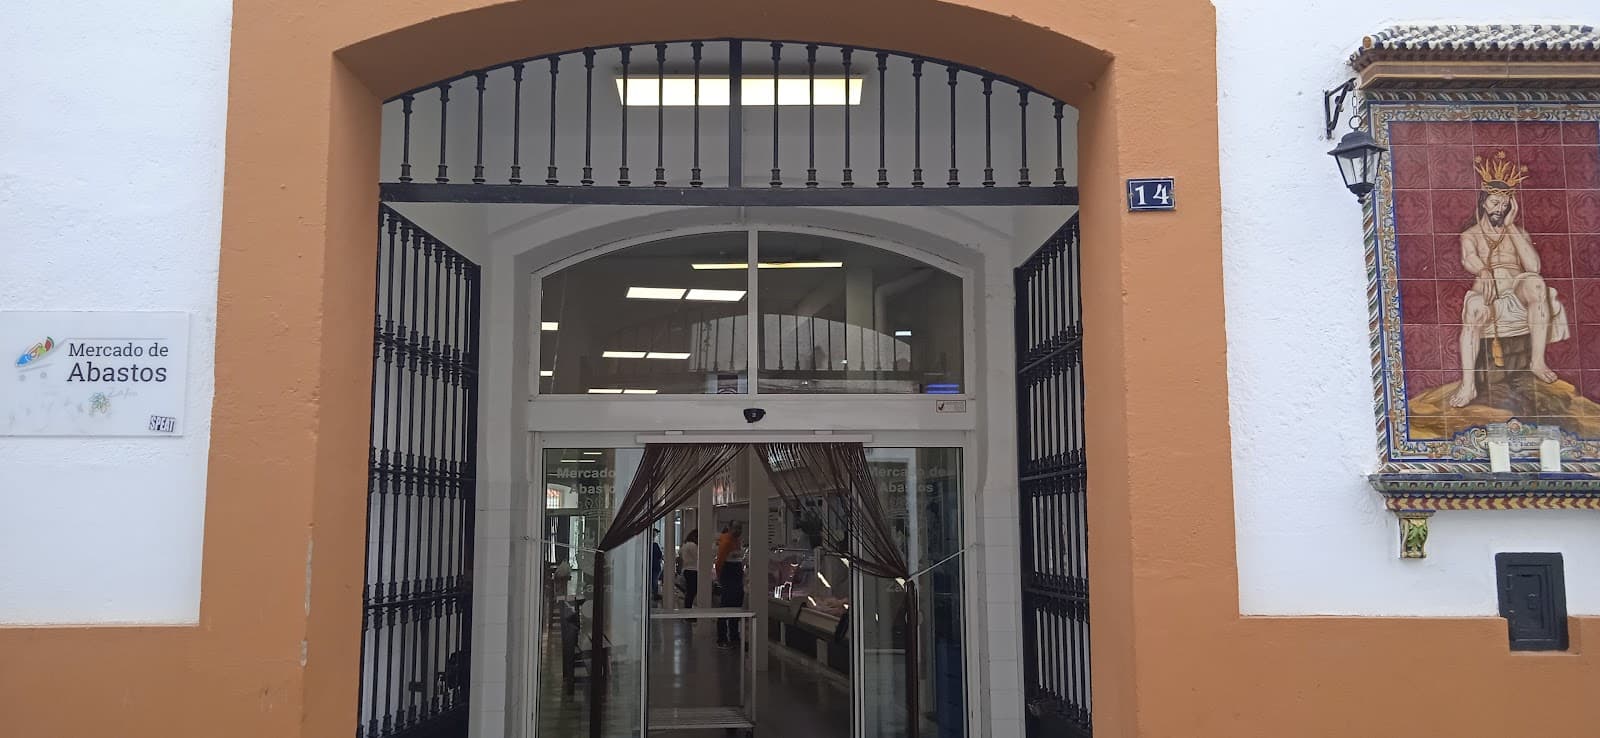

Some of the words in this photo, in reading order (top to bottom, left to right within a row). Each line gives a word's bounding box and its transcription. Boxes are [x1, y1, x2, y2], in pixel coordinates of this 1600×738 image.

[1135, 184, 1169, 205] 14
[68, 342, 144, 357] Mercado
[148, 342, 169, 357] de
[66, 361, 168, 382] Abastos
[556, 467, 617, 479] Mercado
